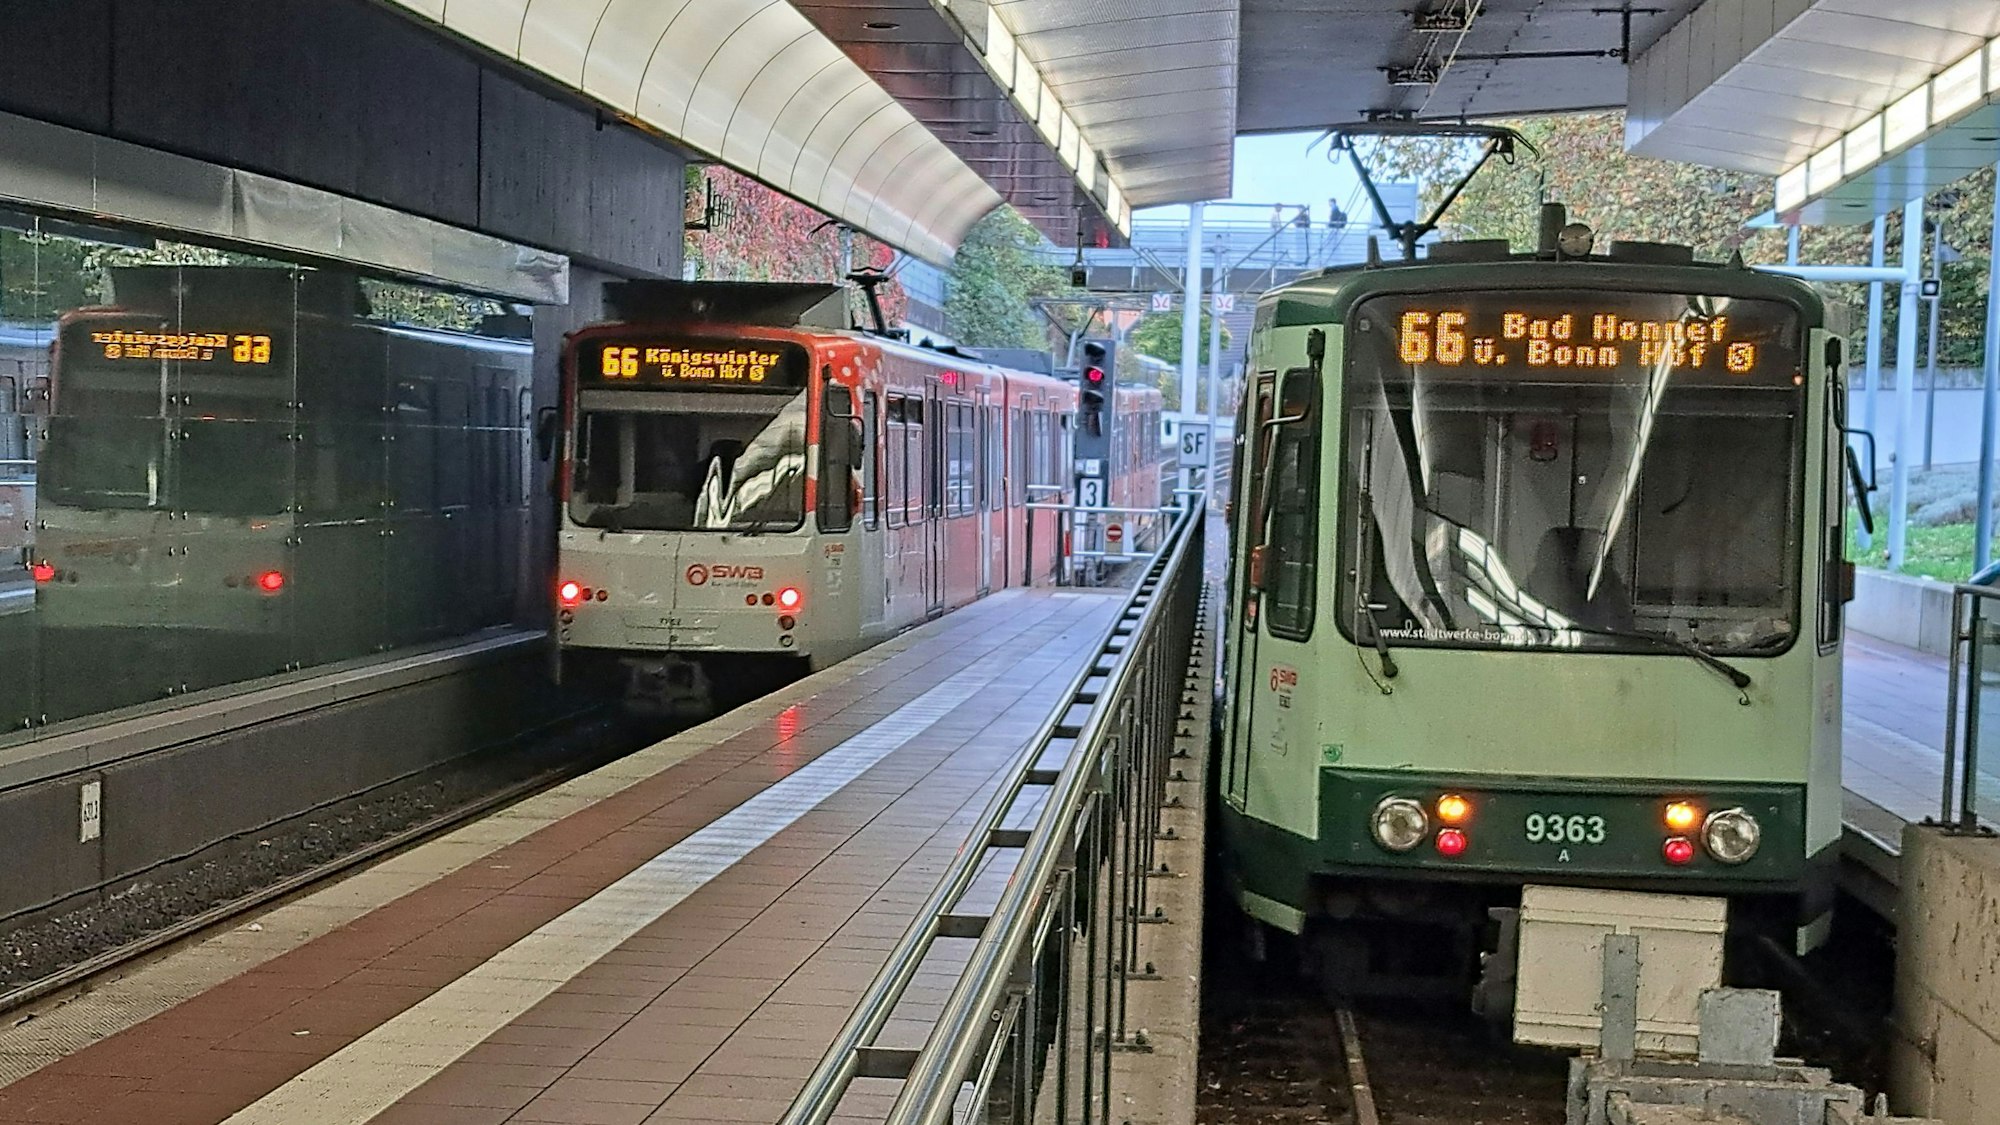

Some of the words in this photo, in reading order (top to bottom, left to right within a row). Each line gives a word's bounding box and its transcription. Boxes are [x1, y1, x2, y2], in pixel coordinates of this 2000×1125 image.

[1400, 311, 1466, 364] 66
[1503, 312, 1572, 340] Bad
[1593, 313, 1727, 342] Honnef
[602, 347, 638, 376] 66
[645, 348, 780, 366] Königswinter
[1473, 337, 1506, 366] ü.
[1528, 339, 1620, 367] Bonn
[1640, 340, 1706, 367] Hbf
[680, 363, 715, 378] Bonn
[719, 364, 745, 379] Hbf
[1183, 432, 1206, 455] SF
[1085, 481, 1098, 507] 3
[711, 564, 764, 580] SWB
[1526, 813, 1606, 843] 9363
[1558, 849, 1570, 862] A
